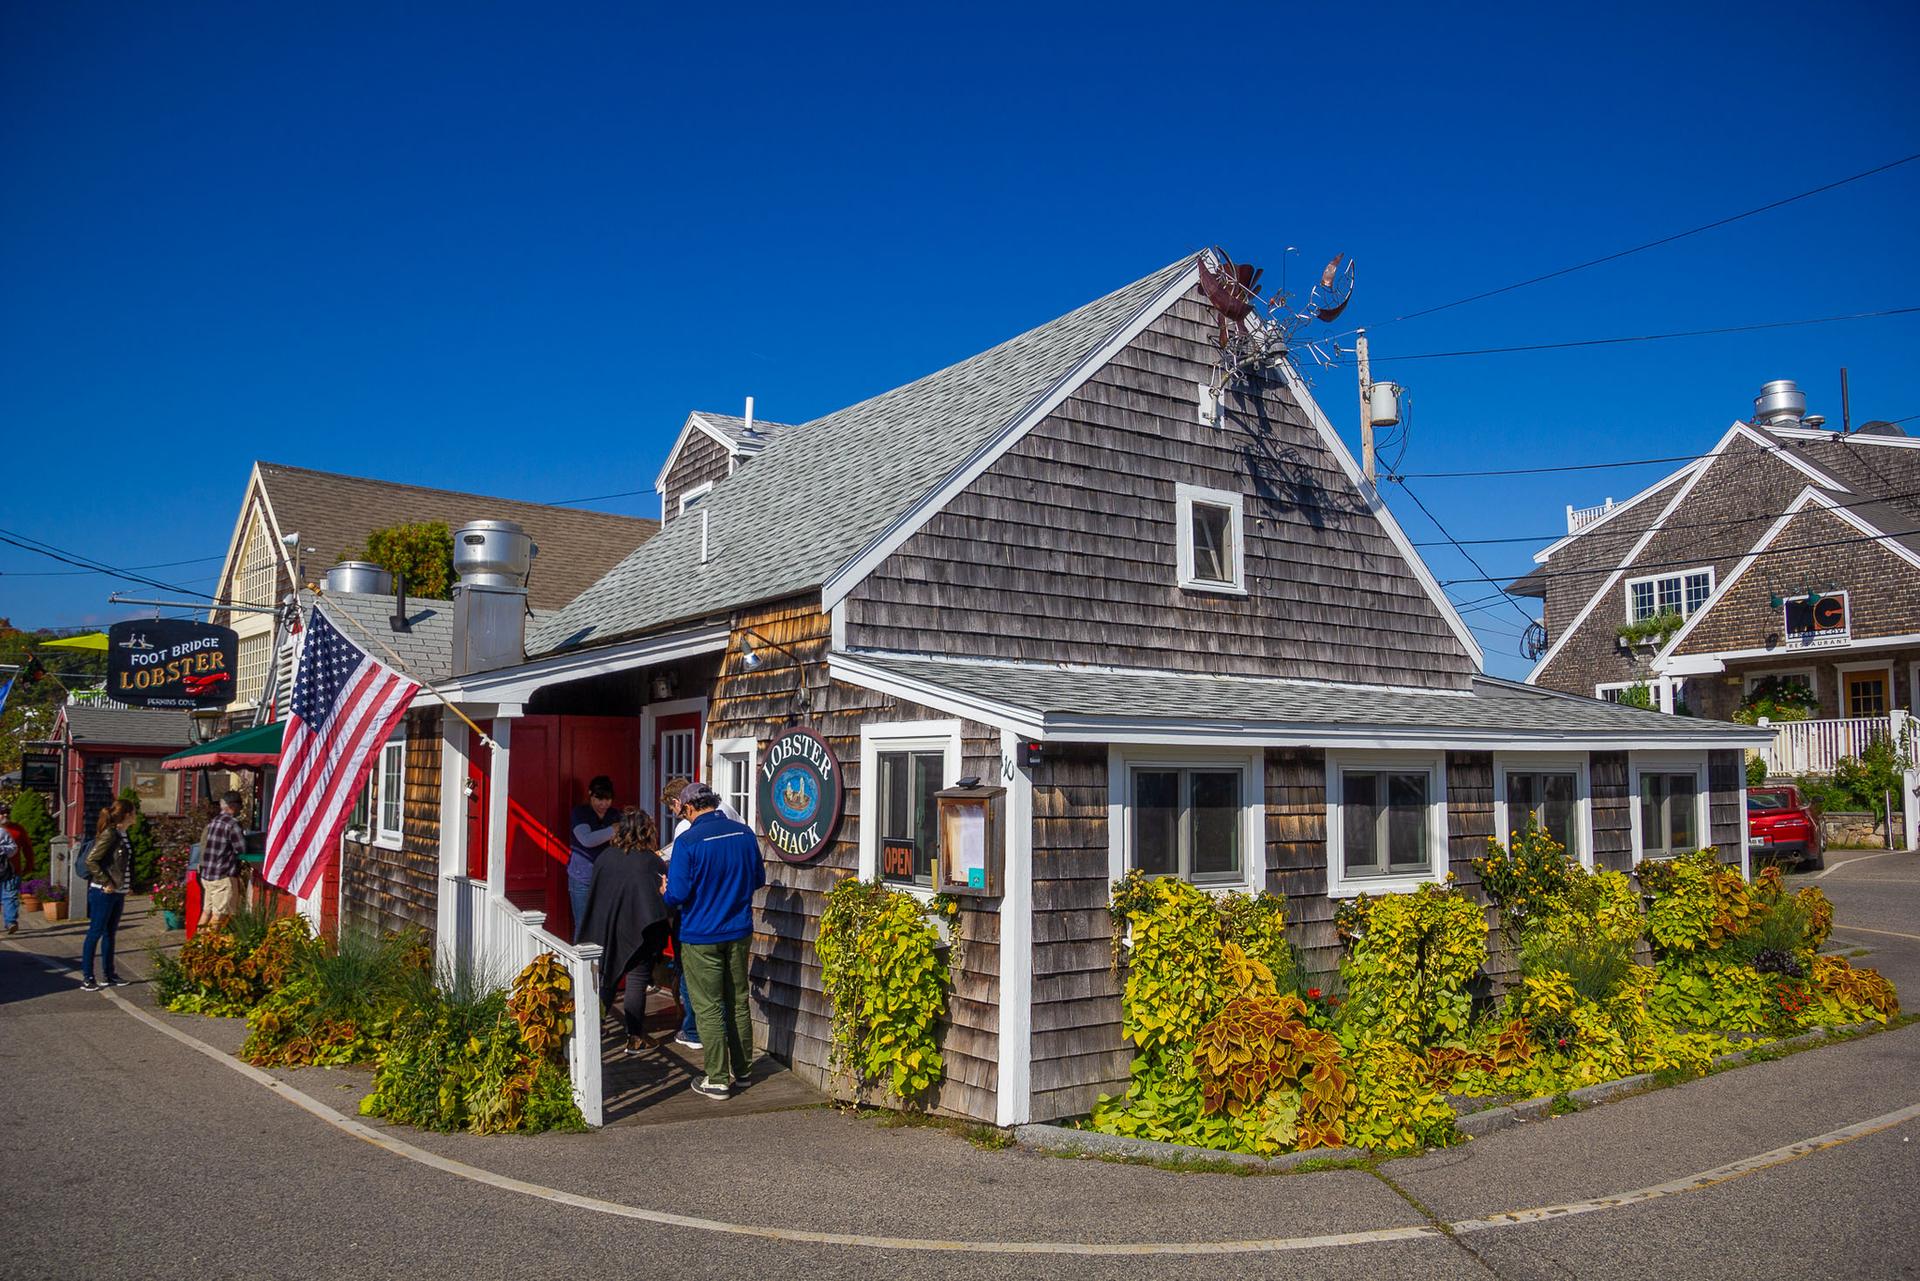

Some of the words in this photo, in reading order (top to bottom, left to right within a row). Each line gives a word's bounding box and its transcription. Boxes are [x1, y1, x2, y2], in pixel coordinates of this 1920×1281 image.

[131, 649, 168, 666] FOOT
[172, 638, 219, 657] BRIDGE
[120, 651, 225, 689] LOBSTER
[762, 734, 832, 782] LOBSTER
[768, 820, 821, 855] SHACK
[884, 847, 913, 876] OPEN
